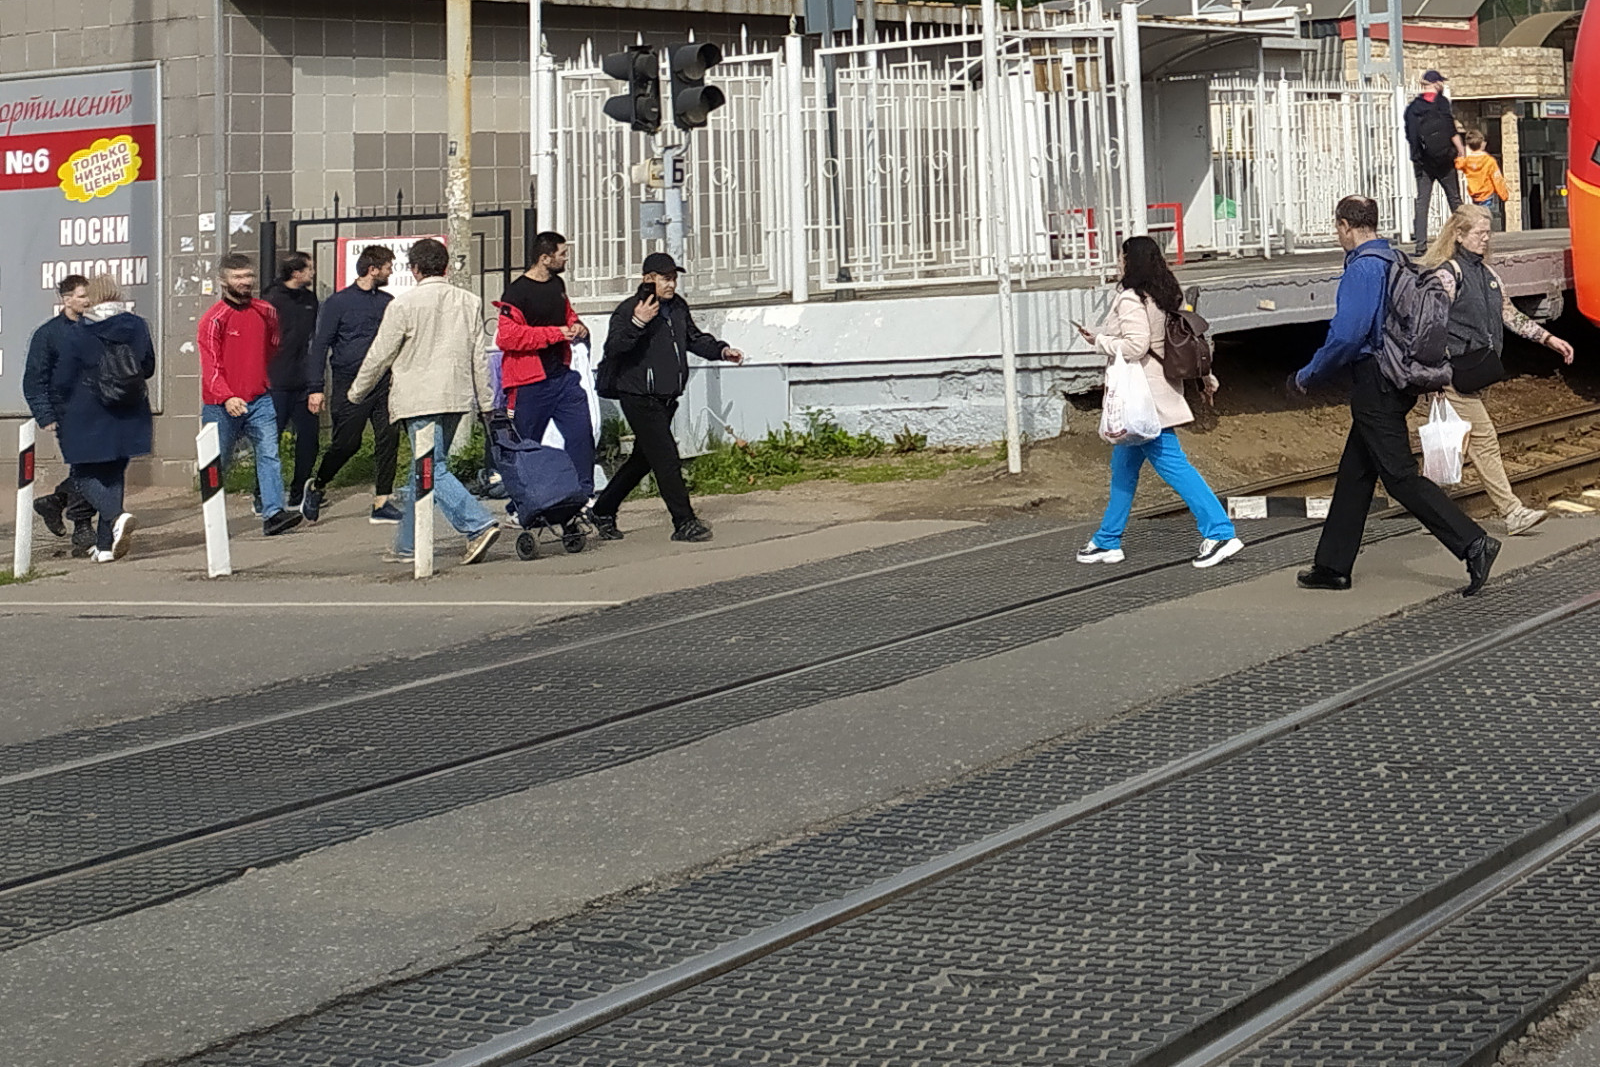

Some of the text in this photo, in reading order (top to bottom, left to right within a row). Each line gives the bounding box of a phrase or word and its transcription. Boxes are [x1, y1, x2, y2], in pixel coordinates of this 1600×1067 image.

[5, 147, 49, 175] №6
[73, 143, 127, 172] ТОЛЬКО
[74, 154, 130, 184] НИЗКИЕ
[84, 168, 125, 193] ЦЕНЫ
[60, 215, 129, 246] НОСКИ
